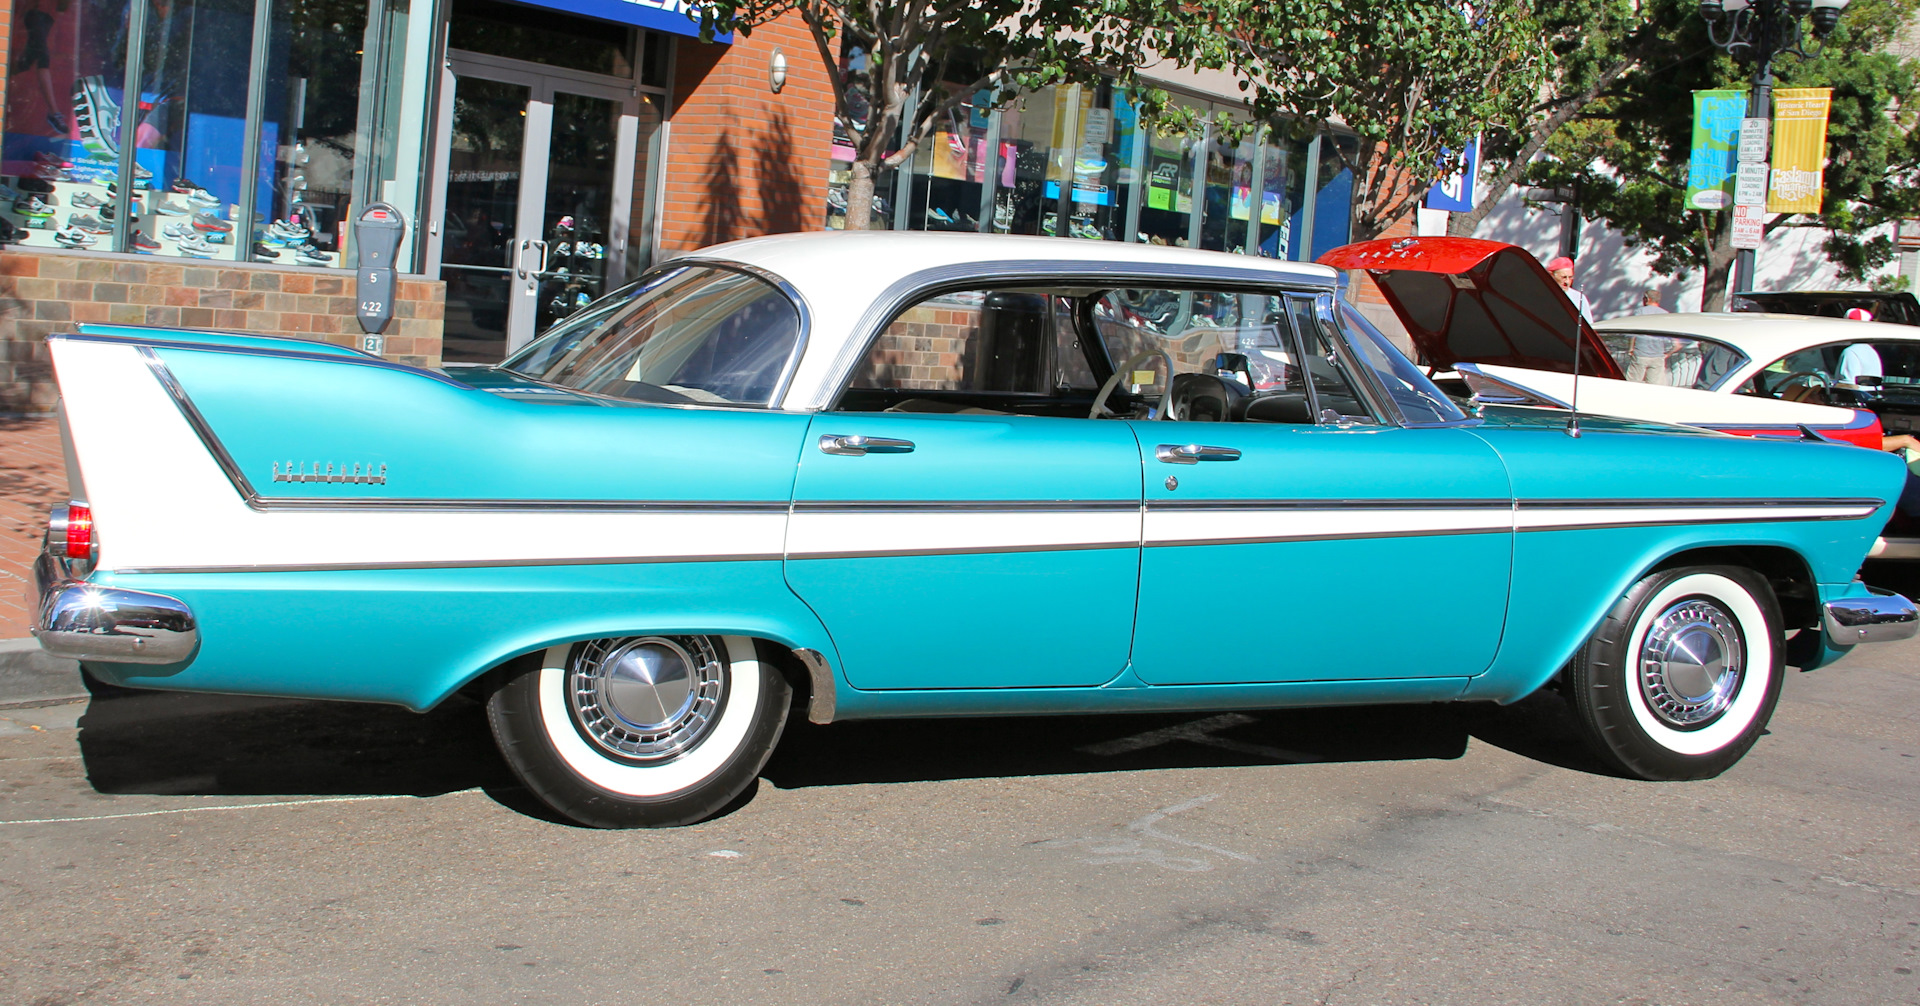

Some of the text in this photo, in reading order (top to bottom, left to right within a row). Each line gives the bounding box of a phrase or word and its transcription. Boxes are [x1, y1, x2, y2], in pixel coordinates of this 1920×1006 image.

[1801, 109, 1822, 117] Diego
[1770, 166, 1820, 190] Gaslamp
[1735, 206, 1746, 217] NO
[1735, 218, 1760, 226] PARKING
[370, 273, 377, 283] 5
[362, 301, 382, 312] 422
[367, 339, 374, 349] 2
